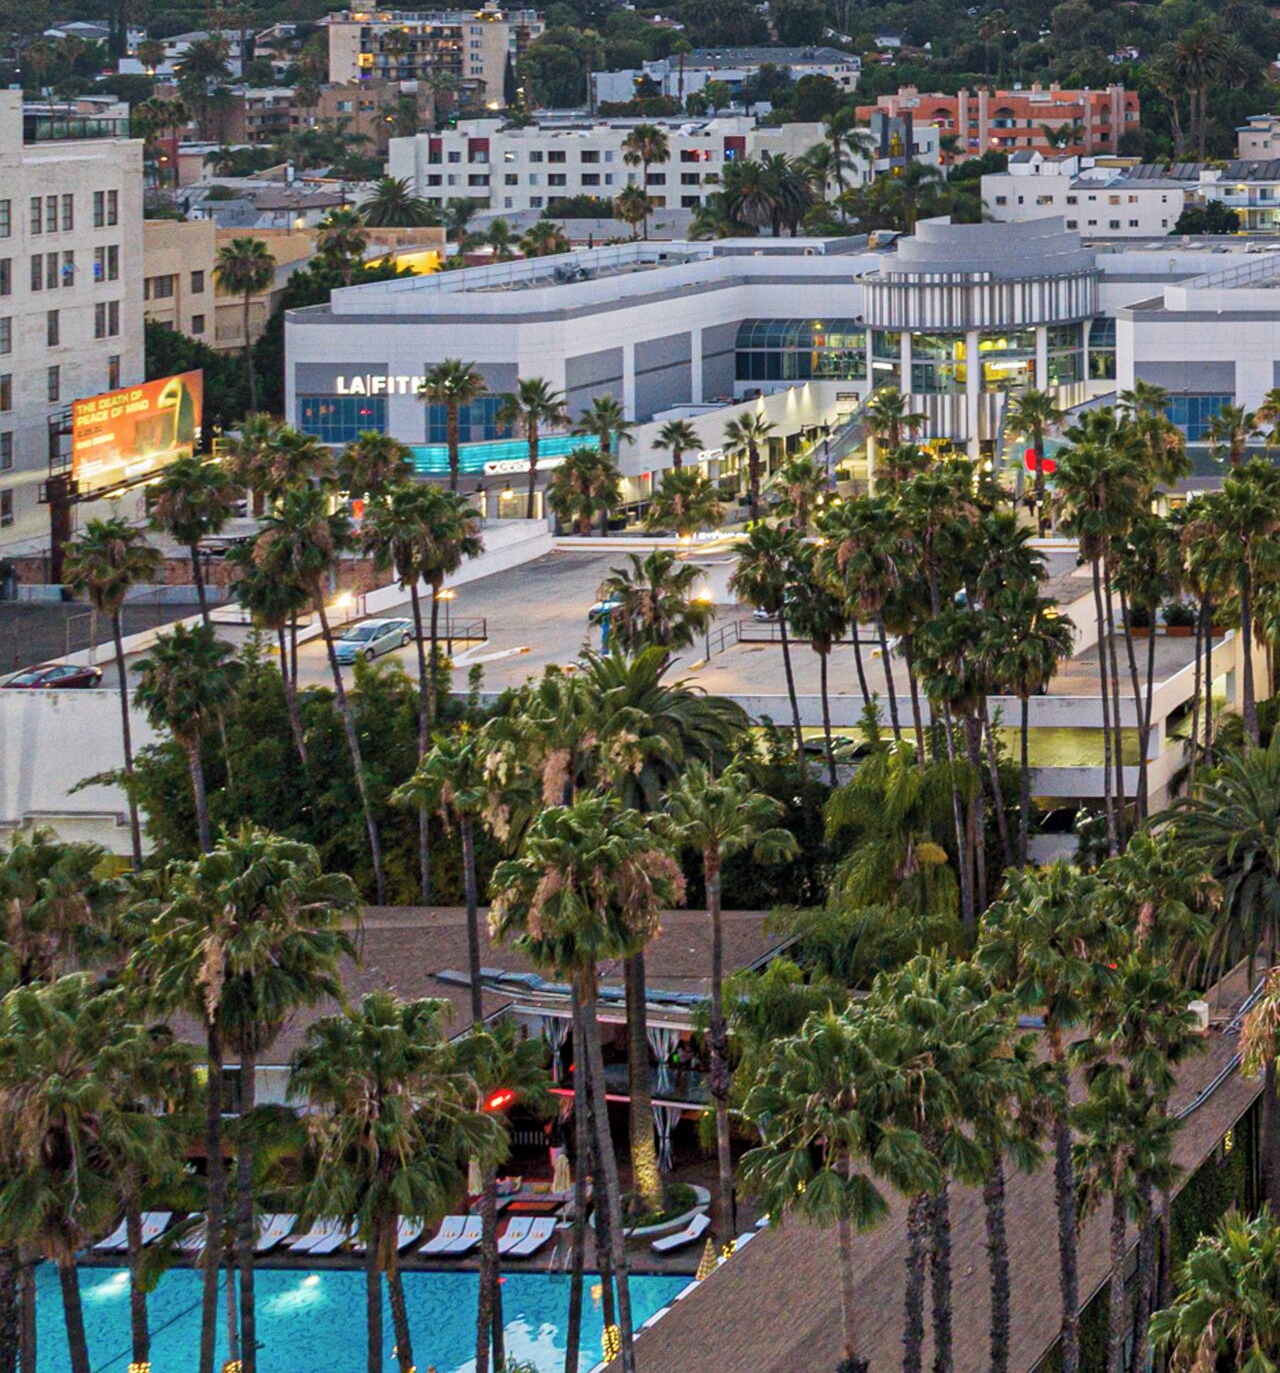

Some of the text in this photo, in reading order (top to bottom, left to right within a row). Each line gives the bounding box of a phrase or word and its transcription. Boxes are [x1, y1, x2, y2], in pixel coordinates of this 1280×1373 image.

[76, 389, 143, 415] THE DEATH OF
[76, 399, 150, 427] PEACE OF MIND
